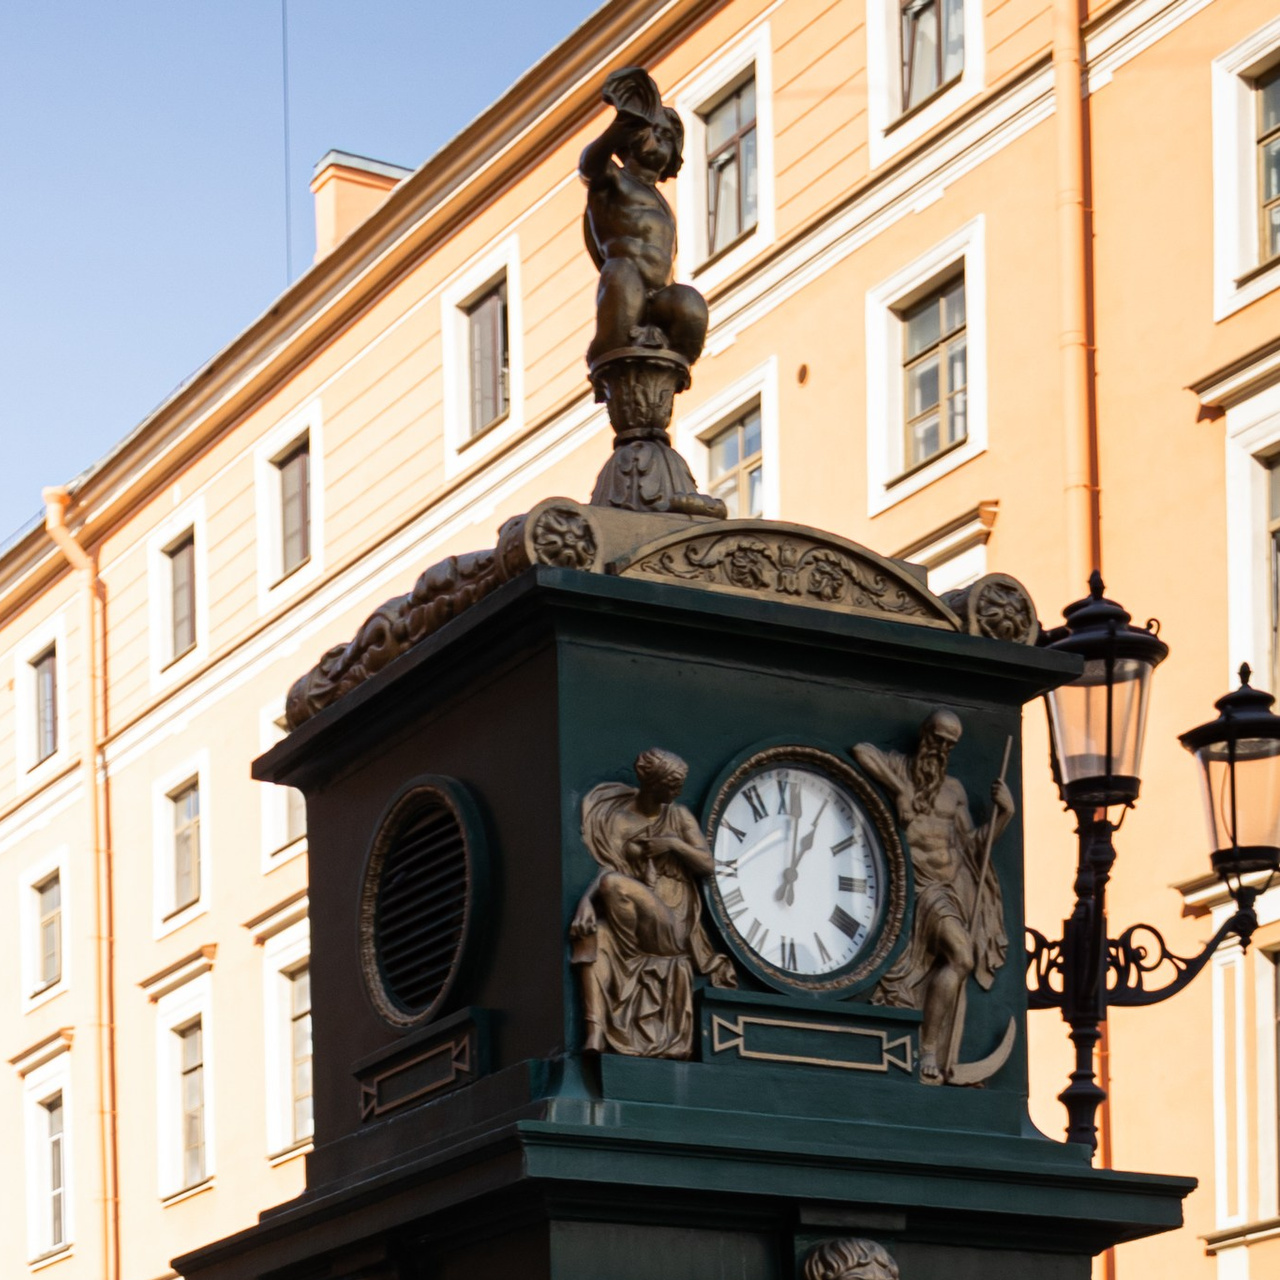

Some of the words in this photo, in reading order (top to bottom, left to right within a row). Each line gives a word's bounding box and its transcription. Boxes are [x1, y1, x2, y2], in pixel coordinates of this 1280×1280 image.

[741, 785, 769, 823] XI
[721, 815, 747, 844] X
[830, 834, 858, 857] II
[838, 875, 867, 894] III
[781, 935, 798, 971] VI
[814, 932, 833, 965] V
